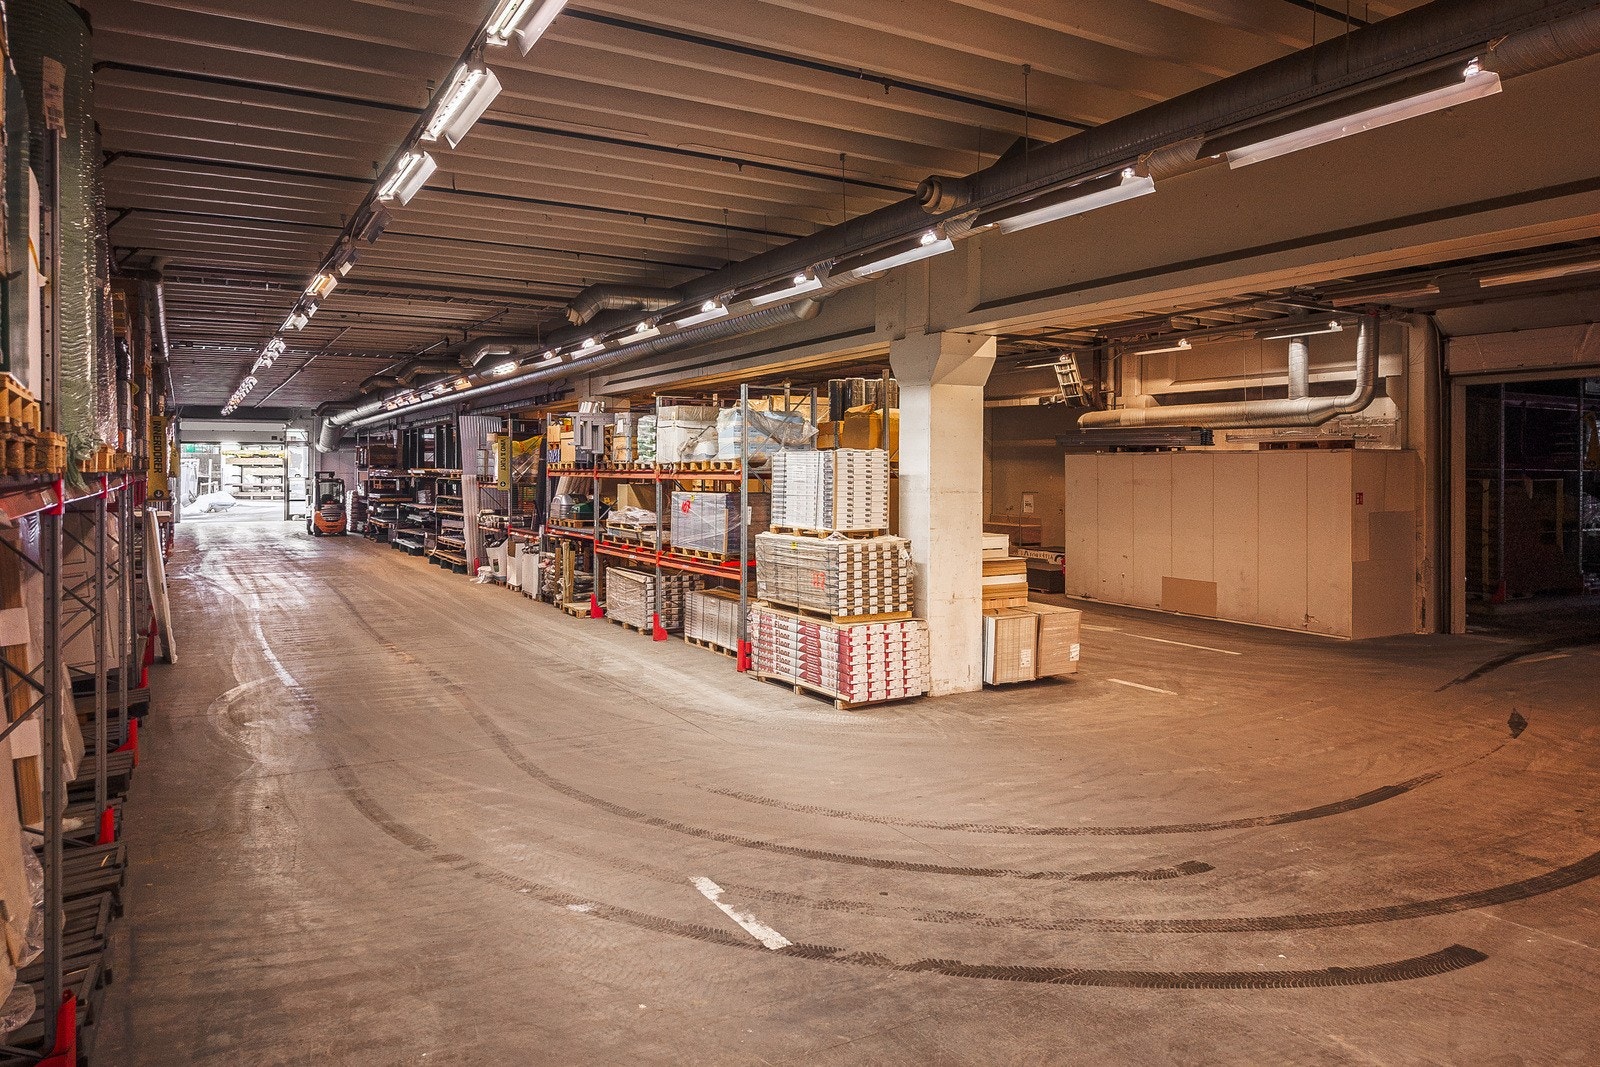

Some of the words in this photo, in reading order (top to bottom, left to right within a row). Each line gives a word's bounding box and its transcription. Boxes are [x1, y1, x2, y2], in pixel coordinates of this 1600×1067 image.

[775, 629, 790, 639] Floor
[775, 637, 790, 648] Floor
[775, 646, 790, 656] Floor
[775, 654, 791, 665] Floor
[775, 662, 791, 673] Floor
